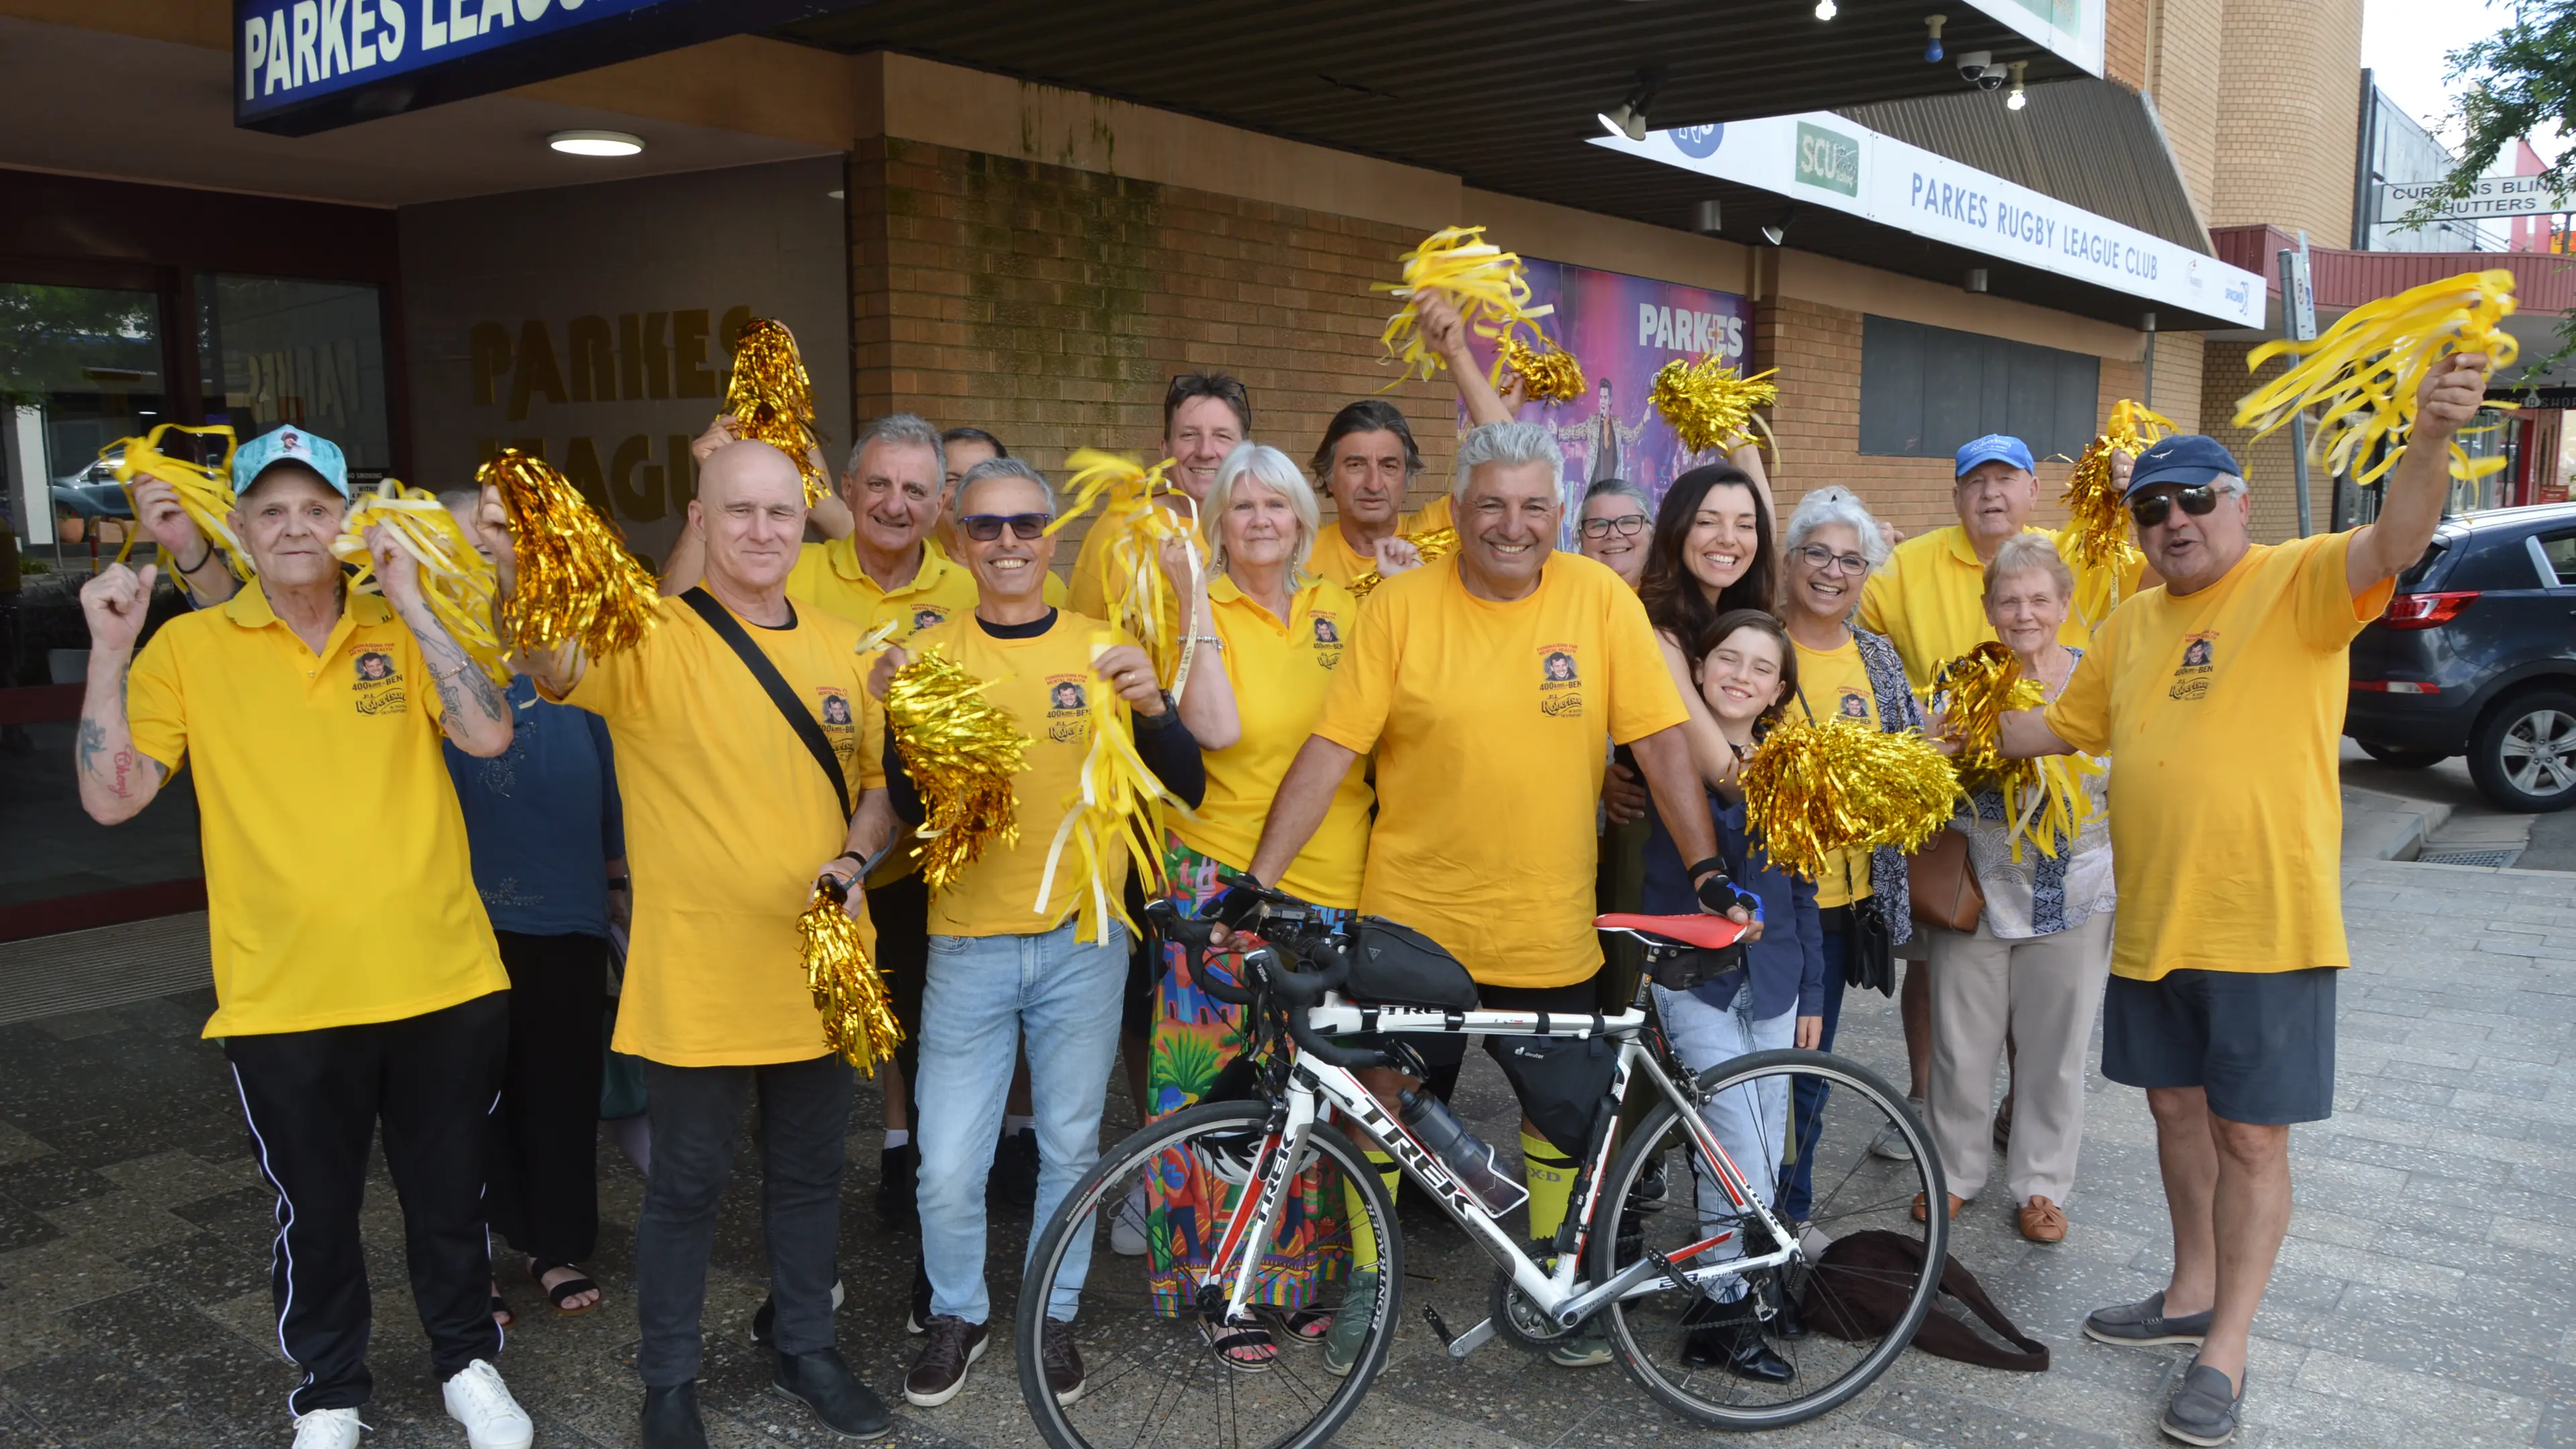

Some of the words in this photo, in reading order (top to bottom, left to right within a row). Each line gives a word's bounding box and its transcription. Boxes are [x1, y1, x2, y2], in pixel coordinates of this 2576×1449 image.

[244, 0, 405, 101] PARKES
[1801, 135, 1837, 178] SCU
[2392, 183, 2491, 200] CURNS
[1911, 172, 1988, 229] PARKES
[1997, 202, 2055, 249] RUGBY
[2063, 224, 2120, 270] LEAGUE
[2125, 246, 2158, 280] CLUB
[1639, 303, 1744, 358] PARKES
[1524, 1051, 1544, 1060] deuter
[1254, 1131, 1297, 1226] TREK
[1362, 1095, 1477, 1221] TREK
[1364, 1199, 1387, 1332] BONTRAGER
